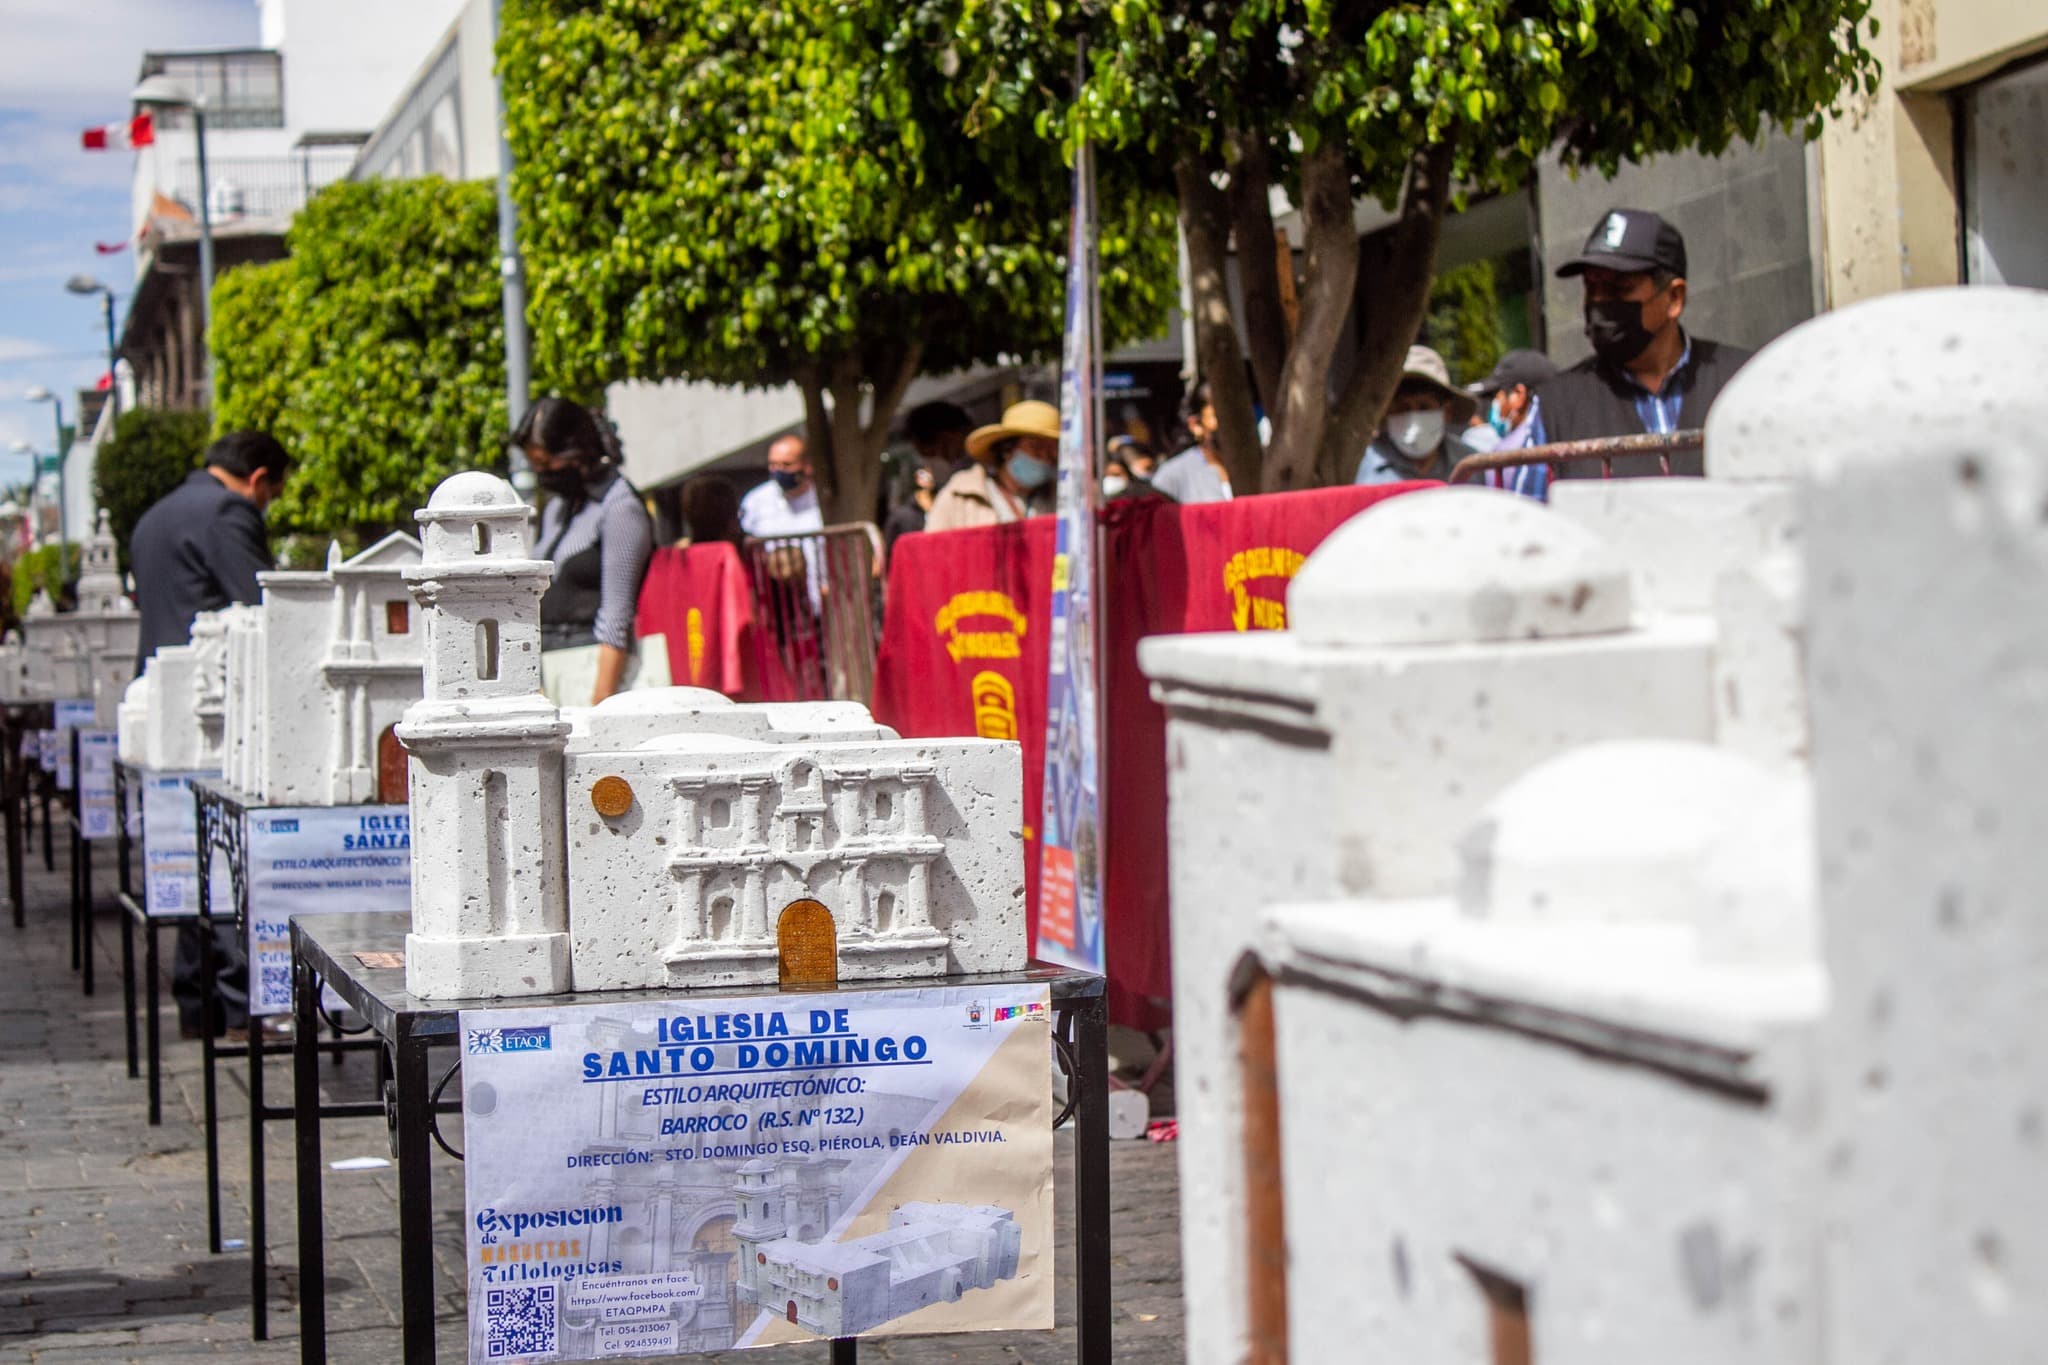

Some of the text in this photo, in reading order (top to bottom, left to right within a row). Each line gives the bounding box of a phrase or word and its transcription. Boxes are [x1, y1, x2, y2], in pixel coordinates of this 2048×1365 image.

[272, 858, 305, 870] ESTILO
[993, 1003, 1044, 1022] AREQUIPA
[657, 1009, 849, 1042] IGLESIA DE
[505, 1035, 547, 1050] ETAQP
[583, 1035, 927, 1078] SANTO DOMINGO
[642, 1075, 866, 1106] ESTILO ARQUITECTÓNICO:
[661, 1113, 748, 1135] BARROCO
[758, 1110, 793, 1132] (R.S.
[567, 1130, 1007, 1169] DIRECCIÓN: STO. DOMINGO ESQ. PIÉROLA, DEÁN VALDIVIA.
[476, 1203, 623, 1237] Exposición
[481, 1232, 498, 1245] de
[481, 1239, 581, 1264] MAQUETAS
[582, 1279, 648, 1291] Encuéntranos
[666, 1274, 690, 1284] face:
[605, 1304, 666, 1318] ETAQPMPA
